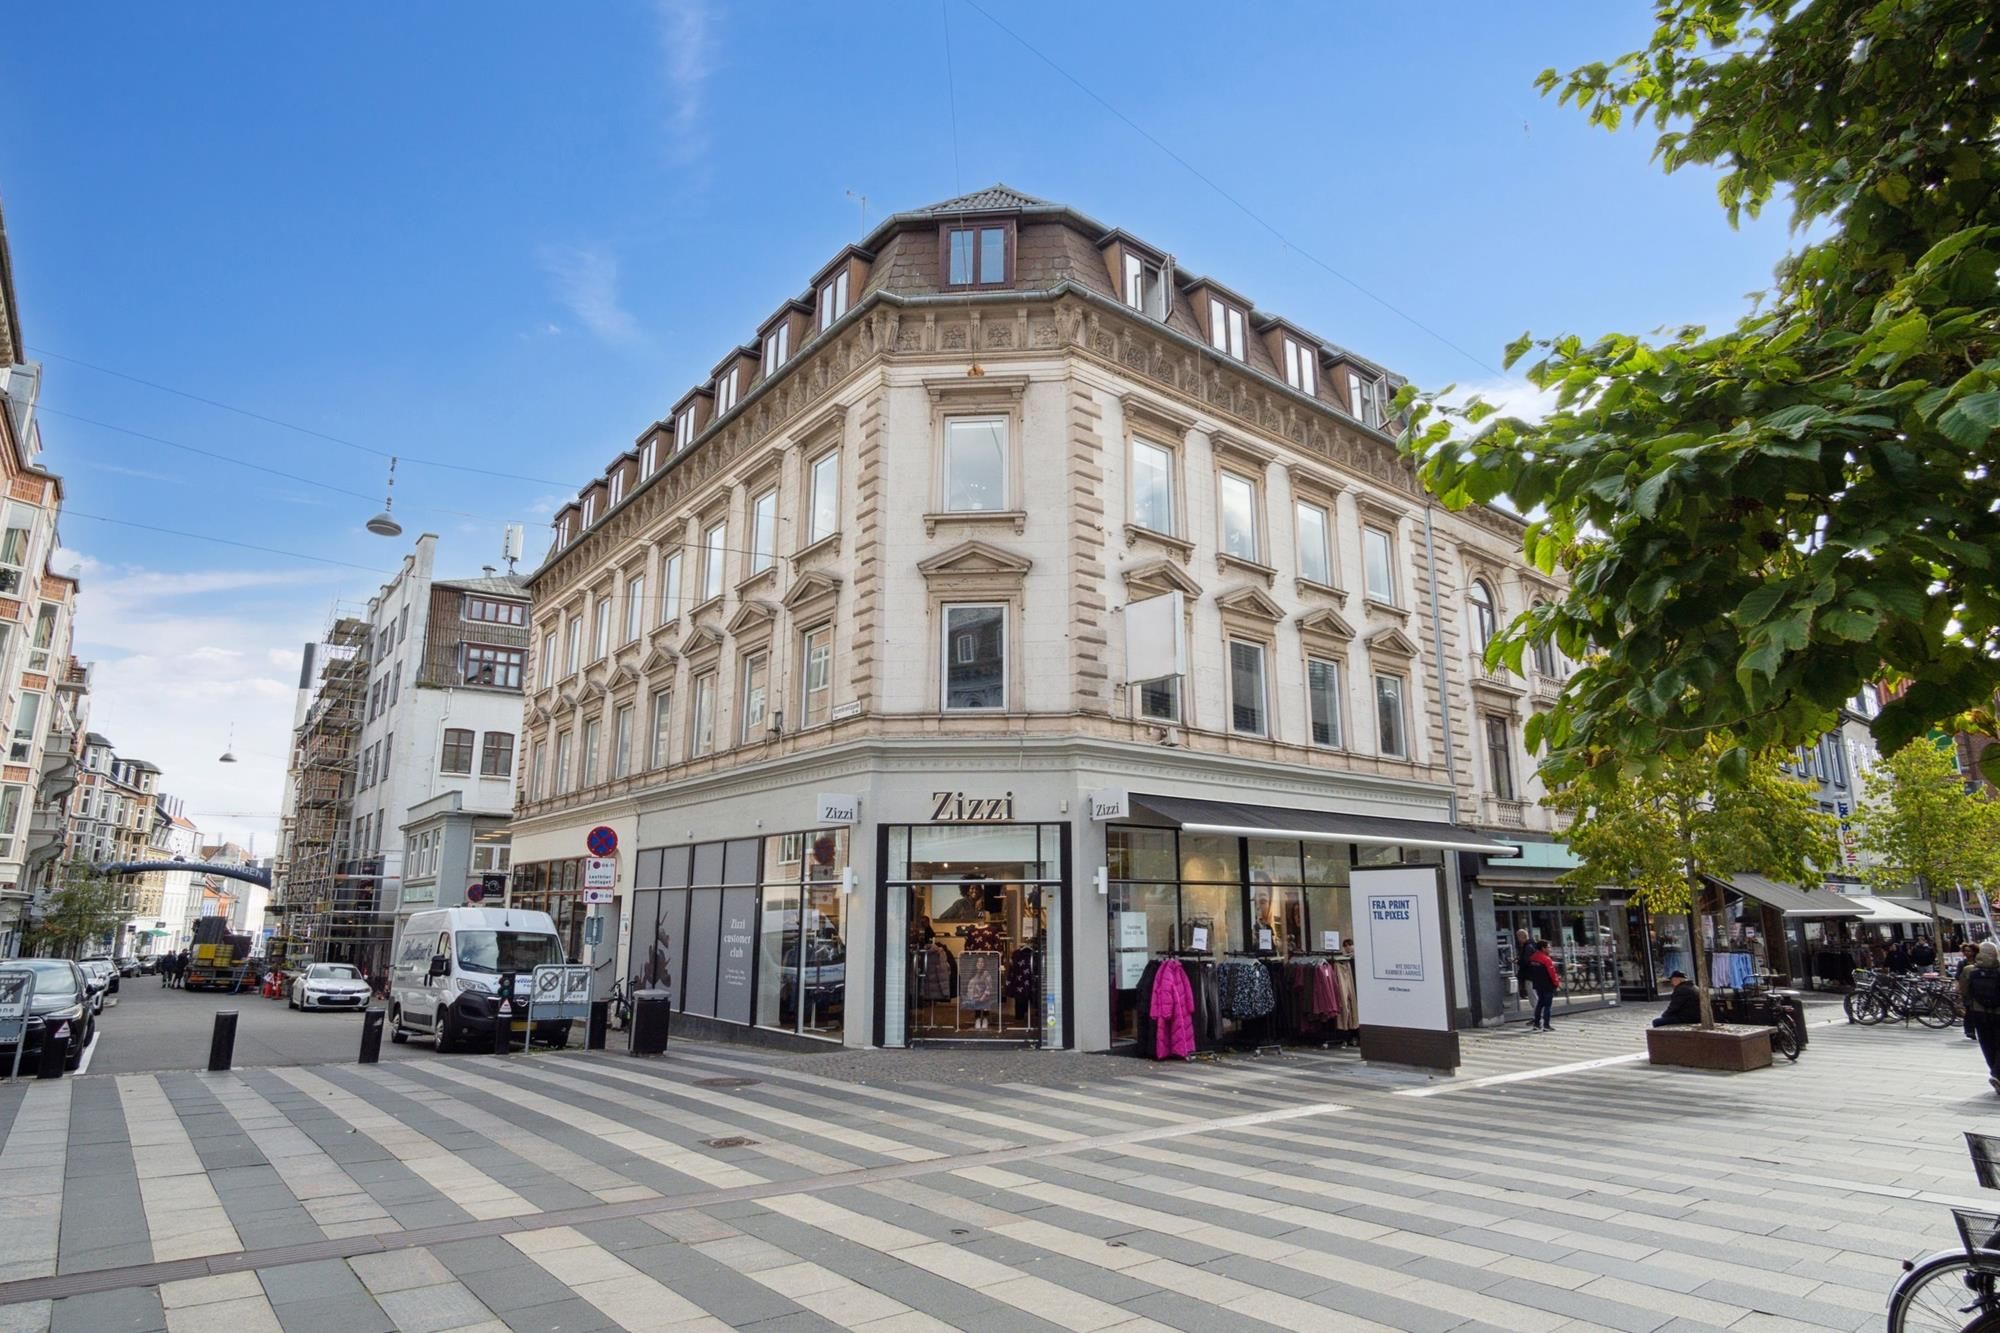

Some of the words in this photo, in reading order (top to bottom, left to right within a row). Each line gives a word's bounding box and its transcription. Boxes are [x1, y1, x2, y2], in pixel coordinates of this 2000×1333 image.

[930, 790, 1016, 821] Zizzi
[1095, 801, 1120, 817] Zizzi
[825, 806, 854, 821] Zizzi
[1372, 900, 1386, 910] FRA
[1388, 900, 1410, 910] PRINT
[1373, 911, 1384, 921] TIL
[1385, 911, 1410, 921] PIXELS
[723, 934, 752, 945] customer
[729, 946, 744, 958] club
